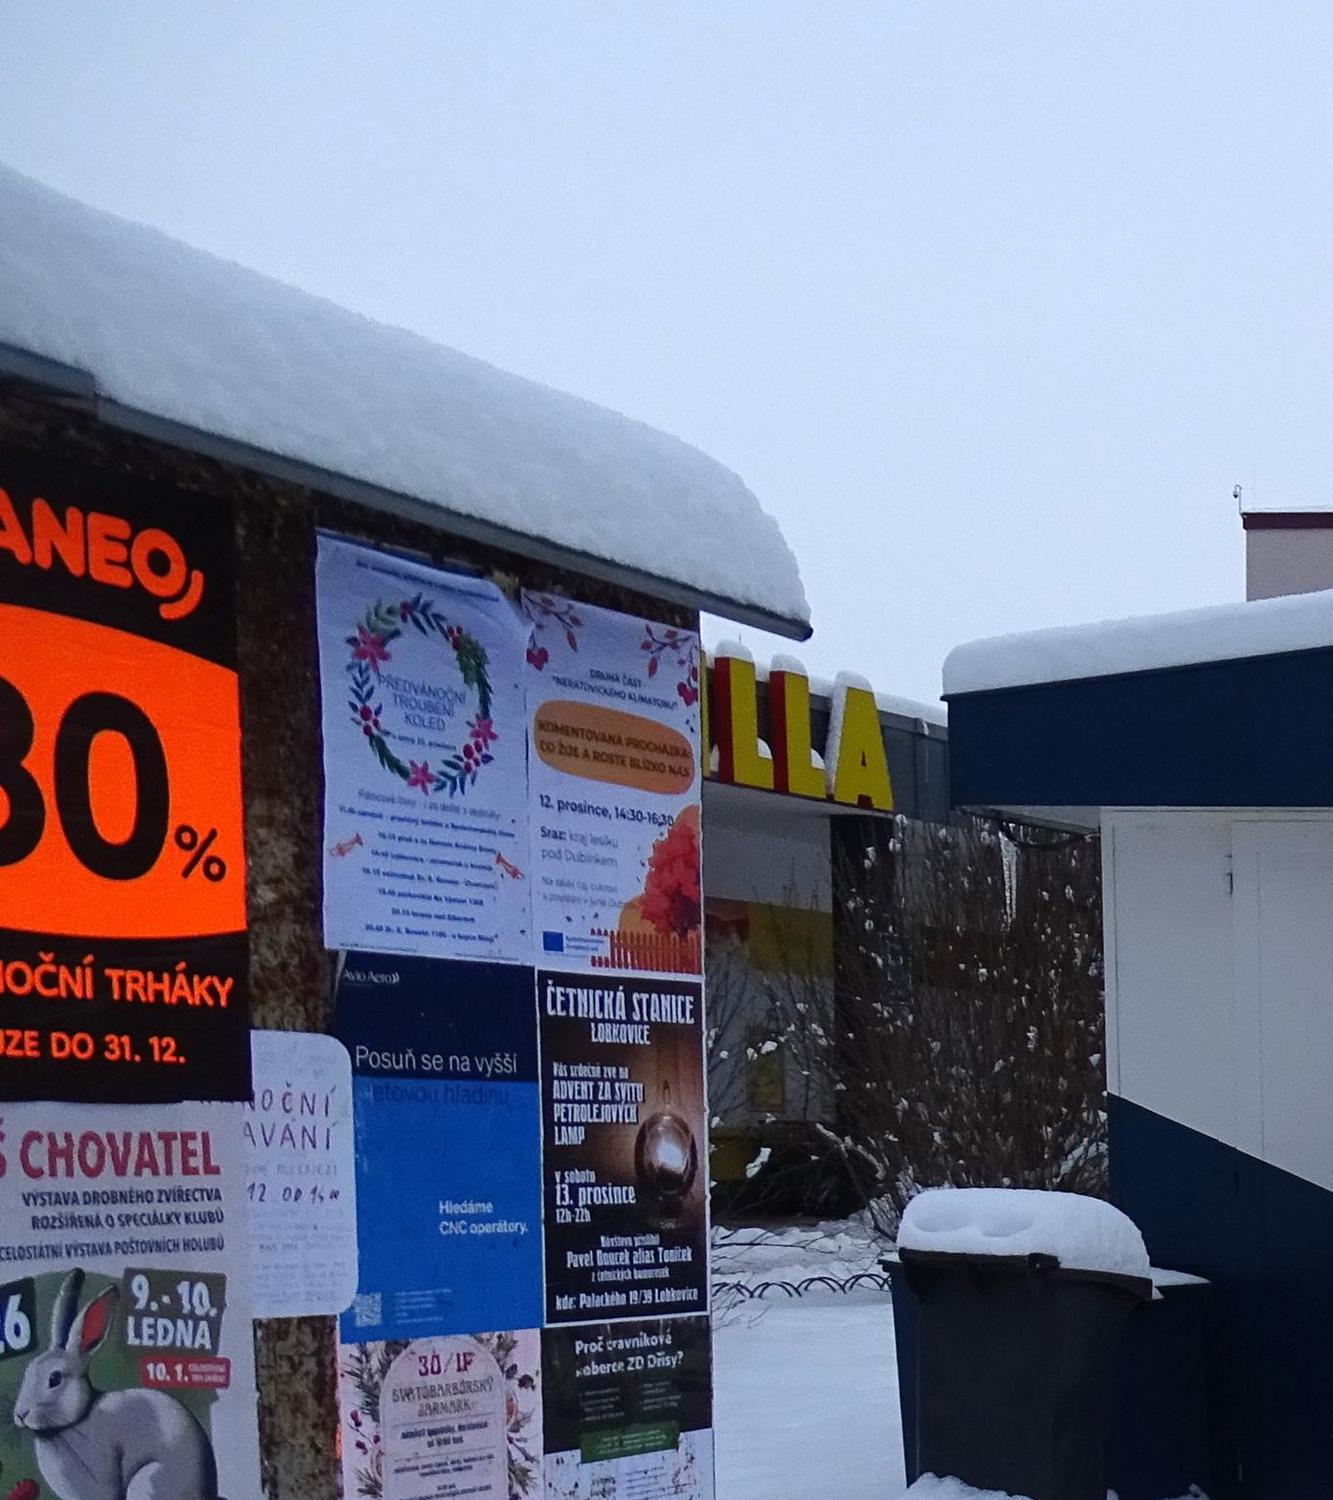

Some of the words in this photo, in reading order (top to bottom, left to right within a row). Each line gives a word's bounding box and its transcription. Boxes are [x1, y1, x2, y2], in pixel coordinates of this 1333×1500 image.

[404, 713, 446, 730] KOLED
[583, 749, 591, 760] A
[593, 750, 627, 766] ROSTE
[539, 794, 554, 809] 12.
[557, 798, 612, 820] prosince,
[615, 807, 675, 827] 14:30-16:30
[0, 952, 94, 999] OČNÍ
[105, 961, 233, 1008] TRHÁKY
[547, 980, 627, 1021] ČETNICKÁ
[632, 992, 695, 1025] STANICE
[591, 1022, 651, 1044] LOBKOVICE
[0, 1029, 40, 1057] ZE
[51, 1031, 94, 1060] DO
[104, 1034, 141, 1062] 31.
[149, 1036, 186, 1063] 12.
[356, 1045, 416, 1070] Posuň
[421, 1054, 443, 1071] se
[449, 1054, 471, 1072] na
[475, 1053, 517, 1078] vyšší
[552, 1062, 568, 1077] Vás
[570, 1063, 601, 1078] srdečně
[603, 1066, 616, 1079] zve
[619, 1067, 629, 1079] na
[553, 1080, 594, 1100] ADVENT
[598, 1081, 612, 1100] ZA
[614, 1082, 644, 1102] SVITU
[554, 1102, 637, 1123] PETROLEJOVÝCH
[555, 1126, 585, 1145] LAMP
[20, 1130, 221, 1179] CHOVATEL
[555, 1171, 561, 1183] v
[565, 1168, 596, 1184] sobotu
[22, 1188, 79, 1207] VÝSTAVA
[82, 1187, 154, 1206] DROBNÉHO
[157, 1184, 223, 1203] ZVÍŘECTVA
[556, 1184, 574, 1206] 13.
[578, 1183, 636, 1207] prosince
[439, 1200, 493, 1214] Hledáme
[556, 1207, 591, 1223] 12h-22h
[31, 1211, 103, 1230] ROZŠÍŘENÁ
[105, 1214, 115, 1228] O
[118, 1209, 181, 1227] SPECIÁLKY
[184, 1206, 224, 1225] KLUBŮ
[439, 1221, 467, 1235] CNC
[470, 1220, 528, 1235] operátory.
[65, 1241, 113, 1258] VÝSTAVA
[567, 1250, 594, 1268] Pavel
[633, 1249, 655, 1265] alias
[579, 1291, 627, 1309] Palackého
[127, 1316, 212, 1349] LEDNA
[575, 1336, 604, 1355] Proč
[147, 1363, 170, 1381] 10.
[174, 1363, 188, 1382] 1.
[626, 1356, 644, 1371] ZD
